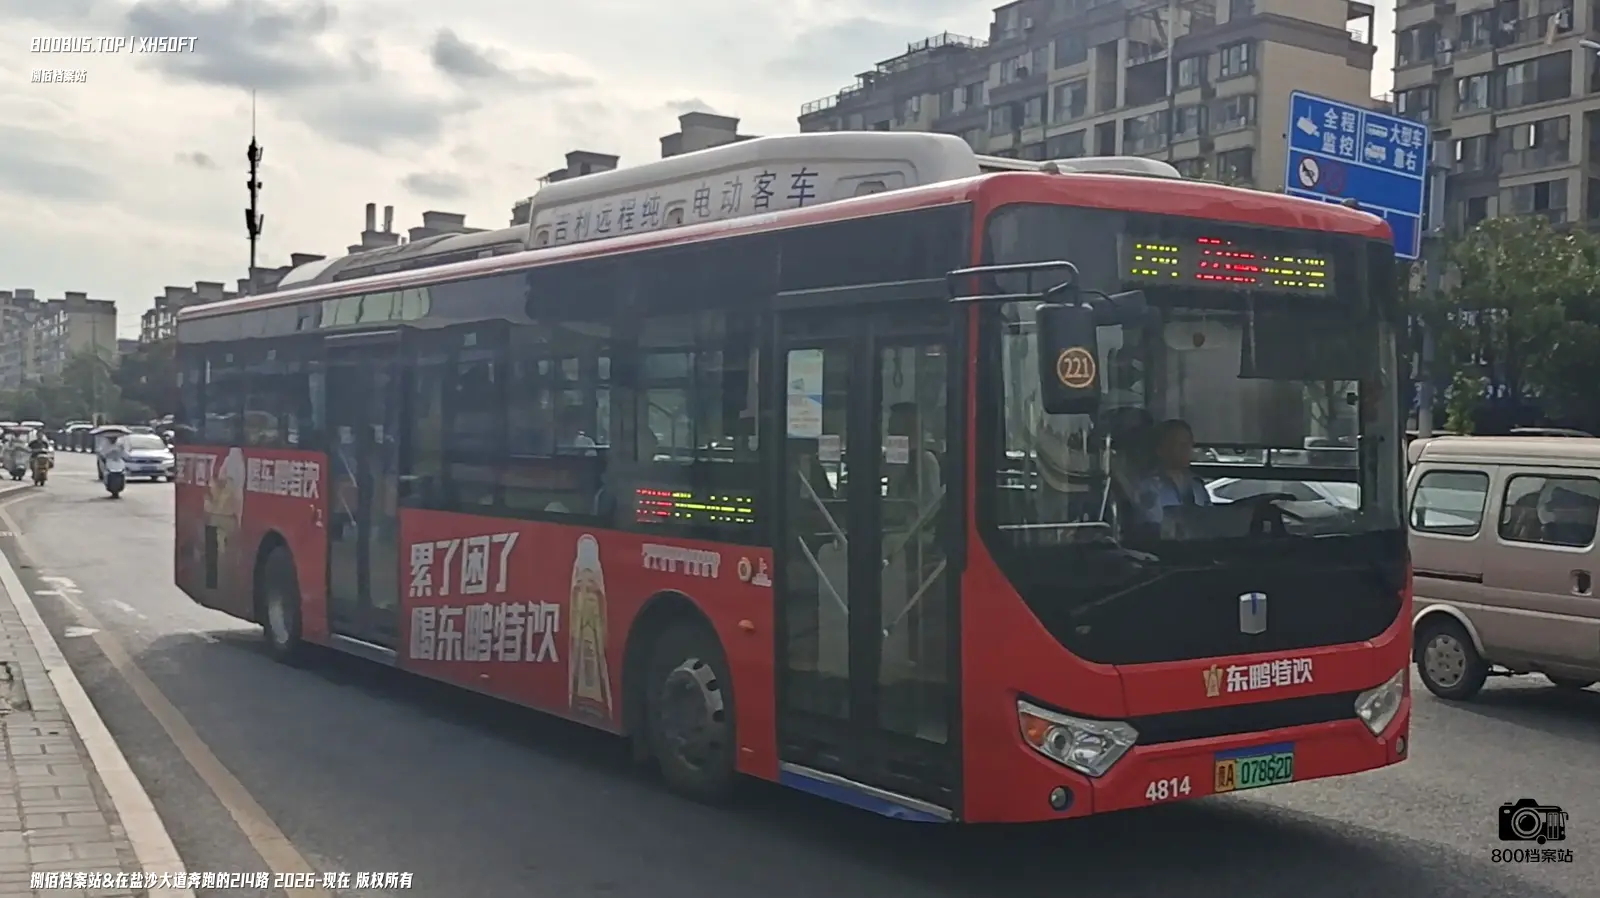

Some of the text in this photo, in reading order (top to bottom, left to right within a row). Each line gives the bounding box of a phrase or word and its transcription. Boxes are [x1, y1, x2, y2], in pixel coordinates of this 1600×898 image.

[1324, 107, 1356, 134] 全程
[1321, 131, 1354, 157] 监控
[1389, 123, 1424, 149] 大型车
[1064, 357, 1090, 378] 221
[409, 531, 520, 598] 累了困了
[409, 600, 561, 662] 喝东鹏特饮
[1226, 657, 1313, 693] 东鹏特饮
[1145, 775, 1192, 801] 4814
